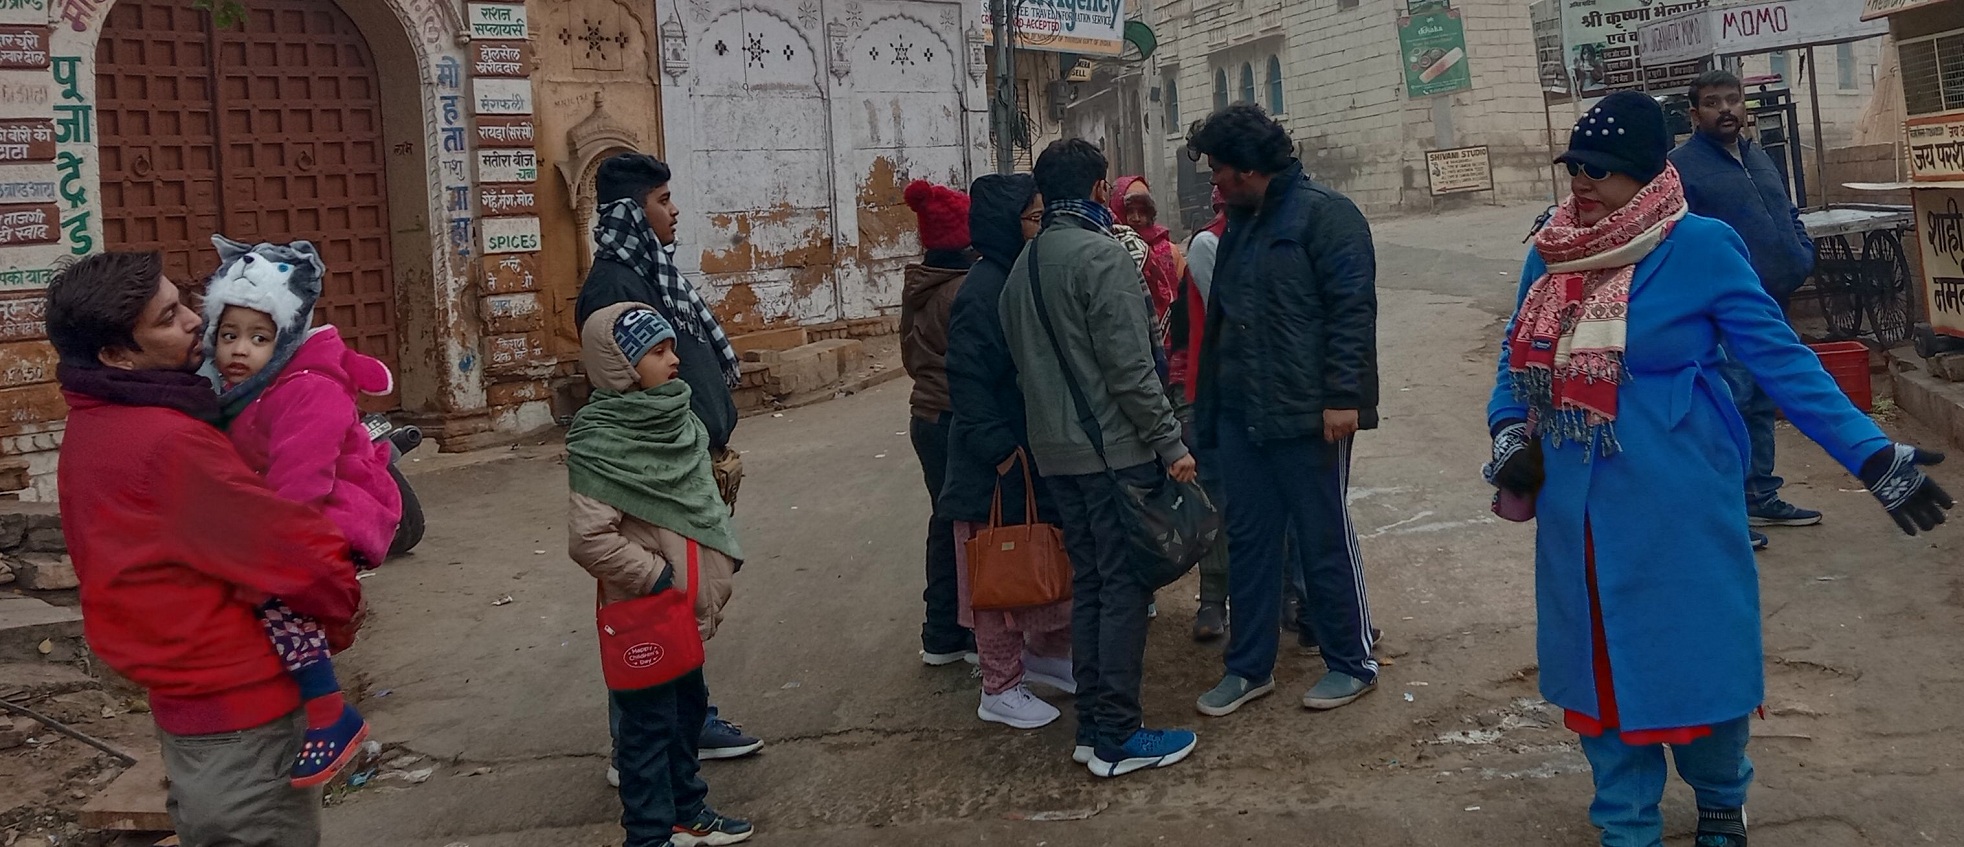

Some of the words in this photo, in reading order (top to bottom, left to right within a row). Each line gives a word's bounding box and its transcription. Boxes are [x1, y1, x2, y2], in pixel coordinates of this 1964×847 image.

[480, 7, 512, 21] राशन
[472, 18, 525, 36] सप्लायर्स
[1722, 6, 1788, 39] MOMO
[1071, 69, 1087, 78] SELL
[1430, 152, 1459, 162] SHIVANI
[1461, 149, 1487, 158] STUDIO
[1911, 143, 1936, 171] जय
[488, 233, 537, 250] SPICES
[629, 650, 660, 662] Children's
[631, 646, 653, 655] Happy
[640, 658, 652, 666] Day
